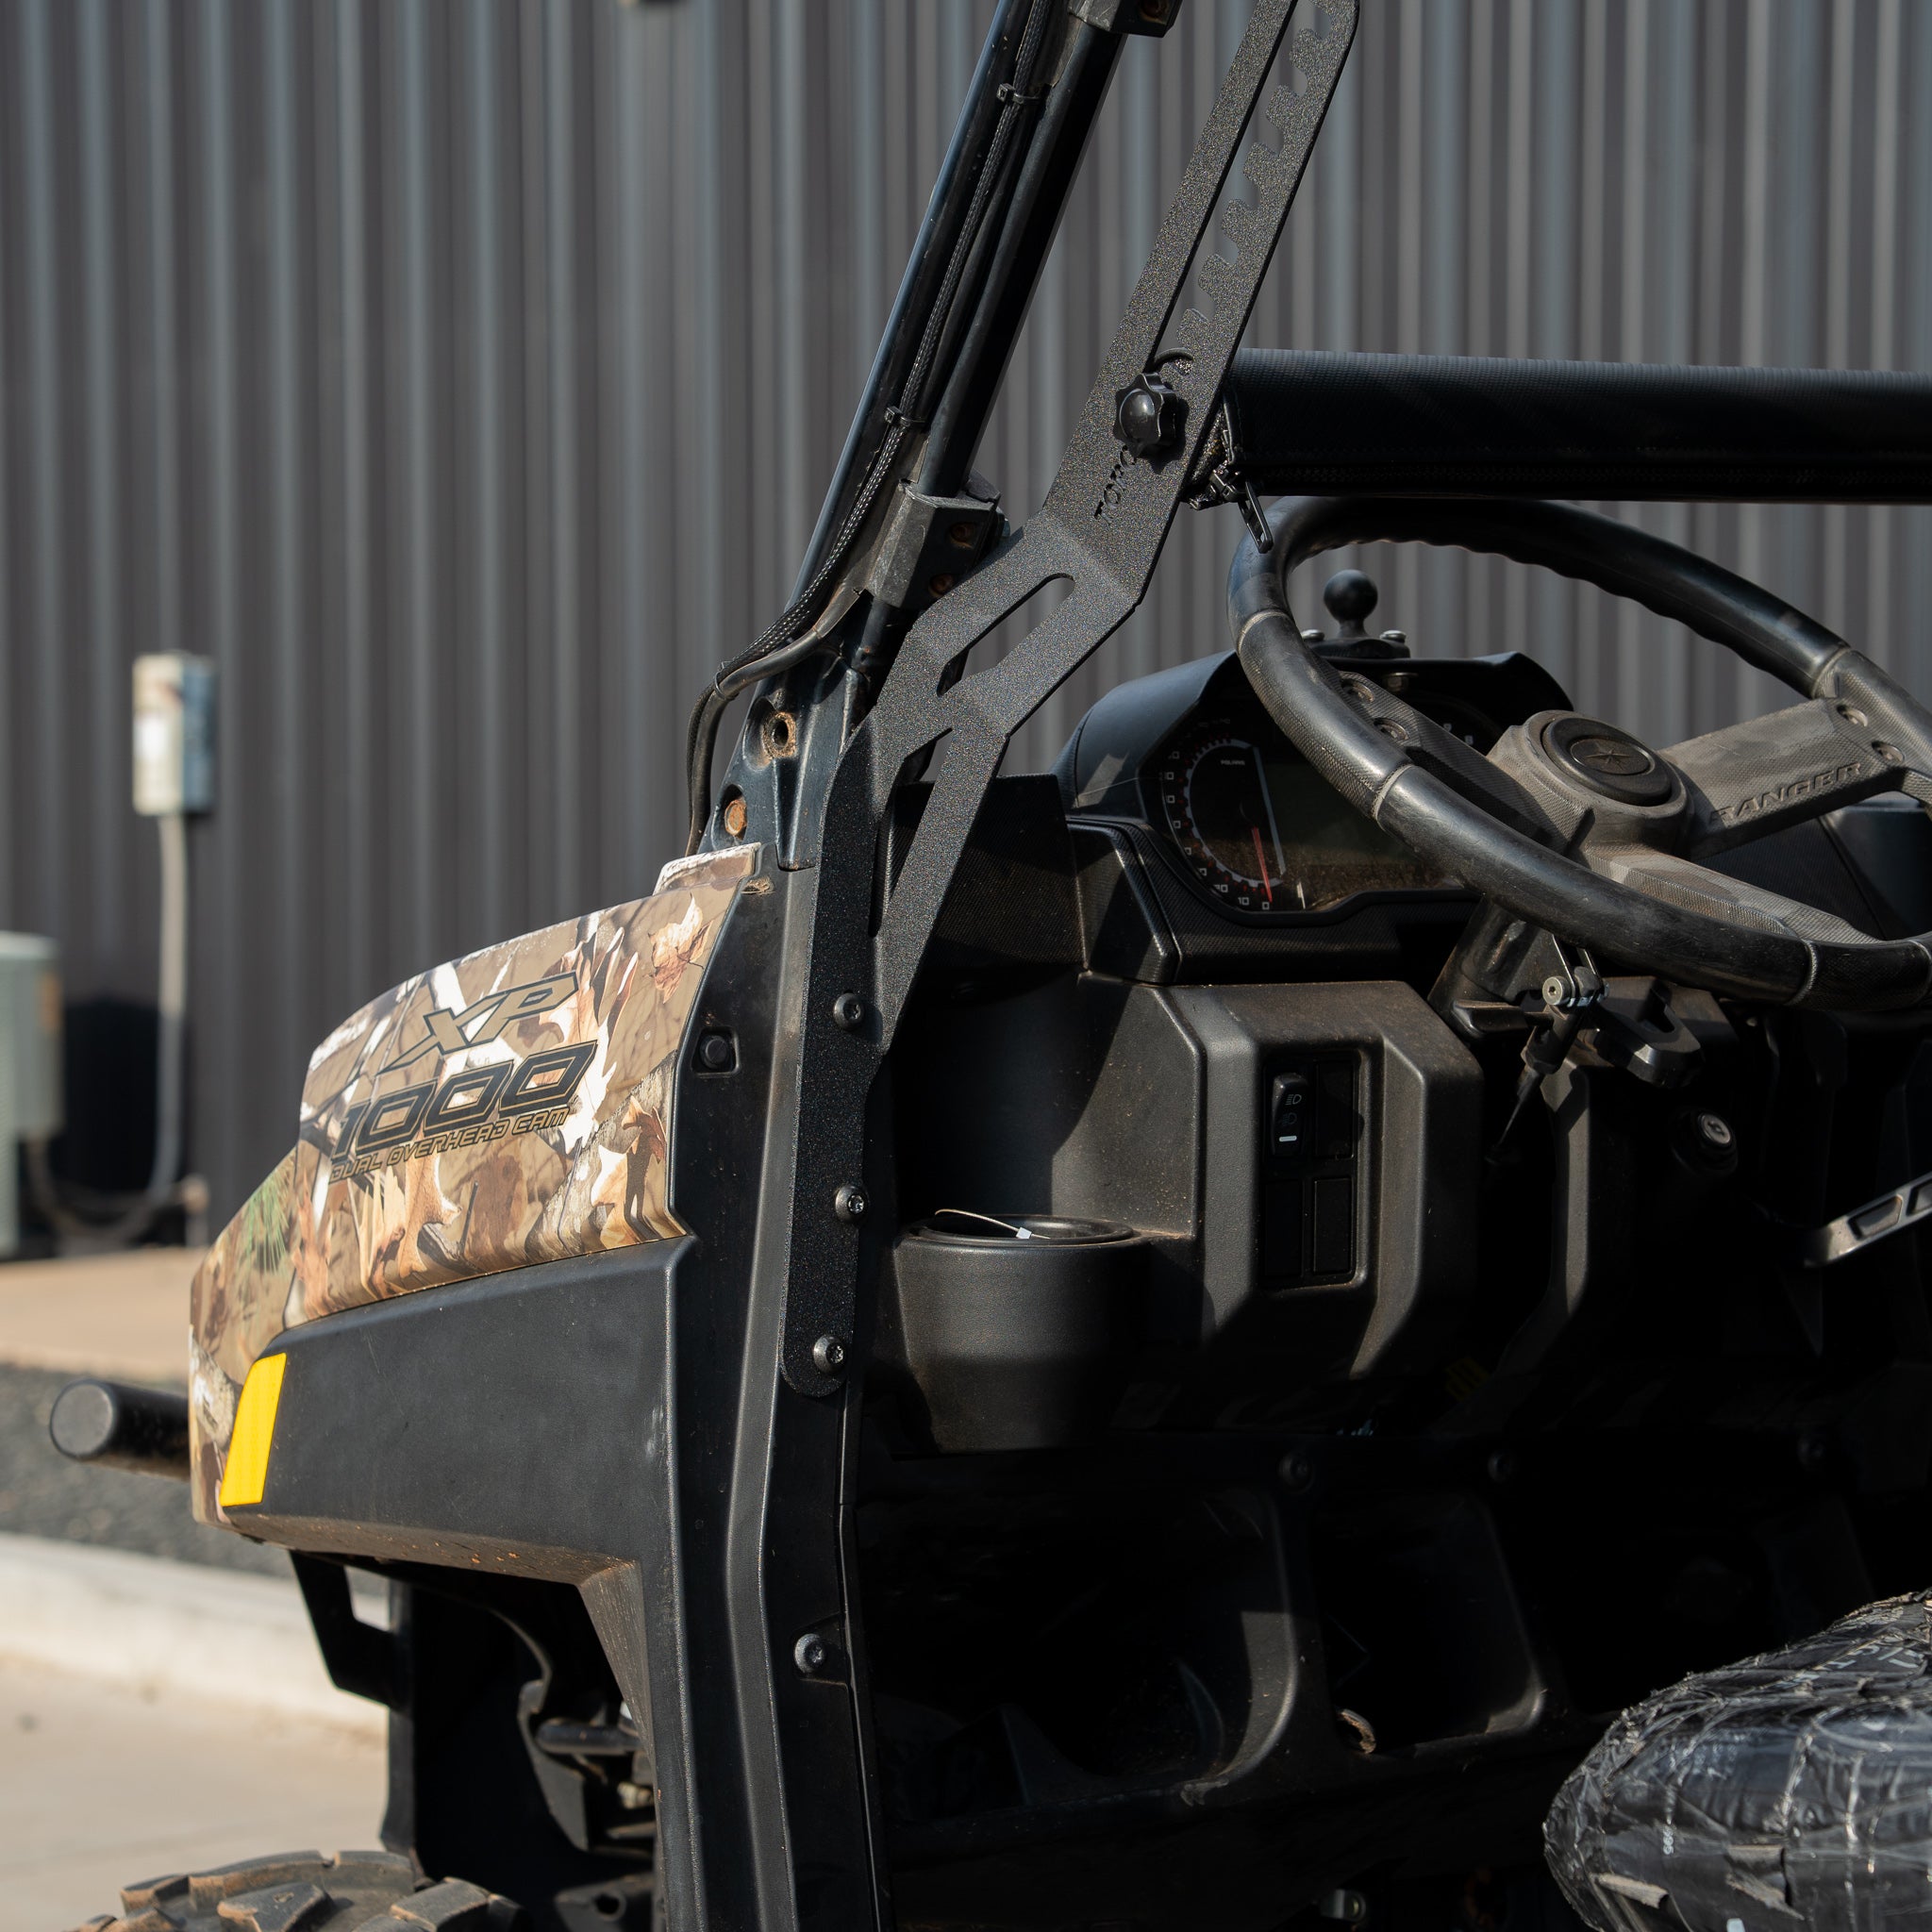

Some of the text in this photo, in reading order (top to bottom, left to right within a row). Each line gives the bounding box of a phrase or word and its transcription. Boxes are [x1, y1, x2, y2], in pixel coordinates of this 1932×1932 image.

[1708, 762, 1861, 826] RANGER
[374, 970, 579, 1077] XP
[327, 1107, 570, 1185] DUAL OVERHEAD CAM
[331, 1040, 597, 1160] 1000
